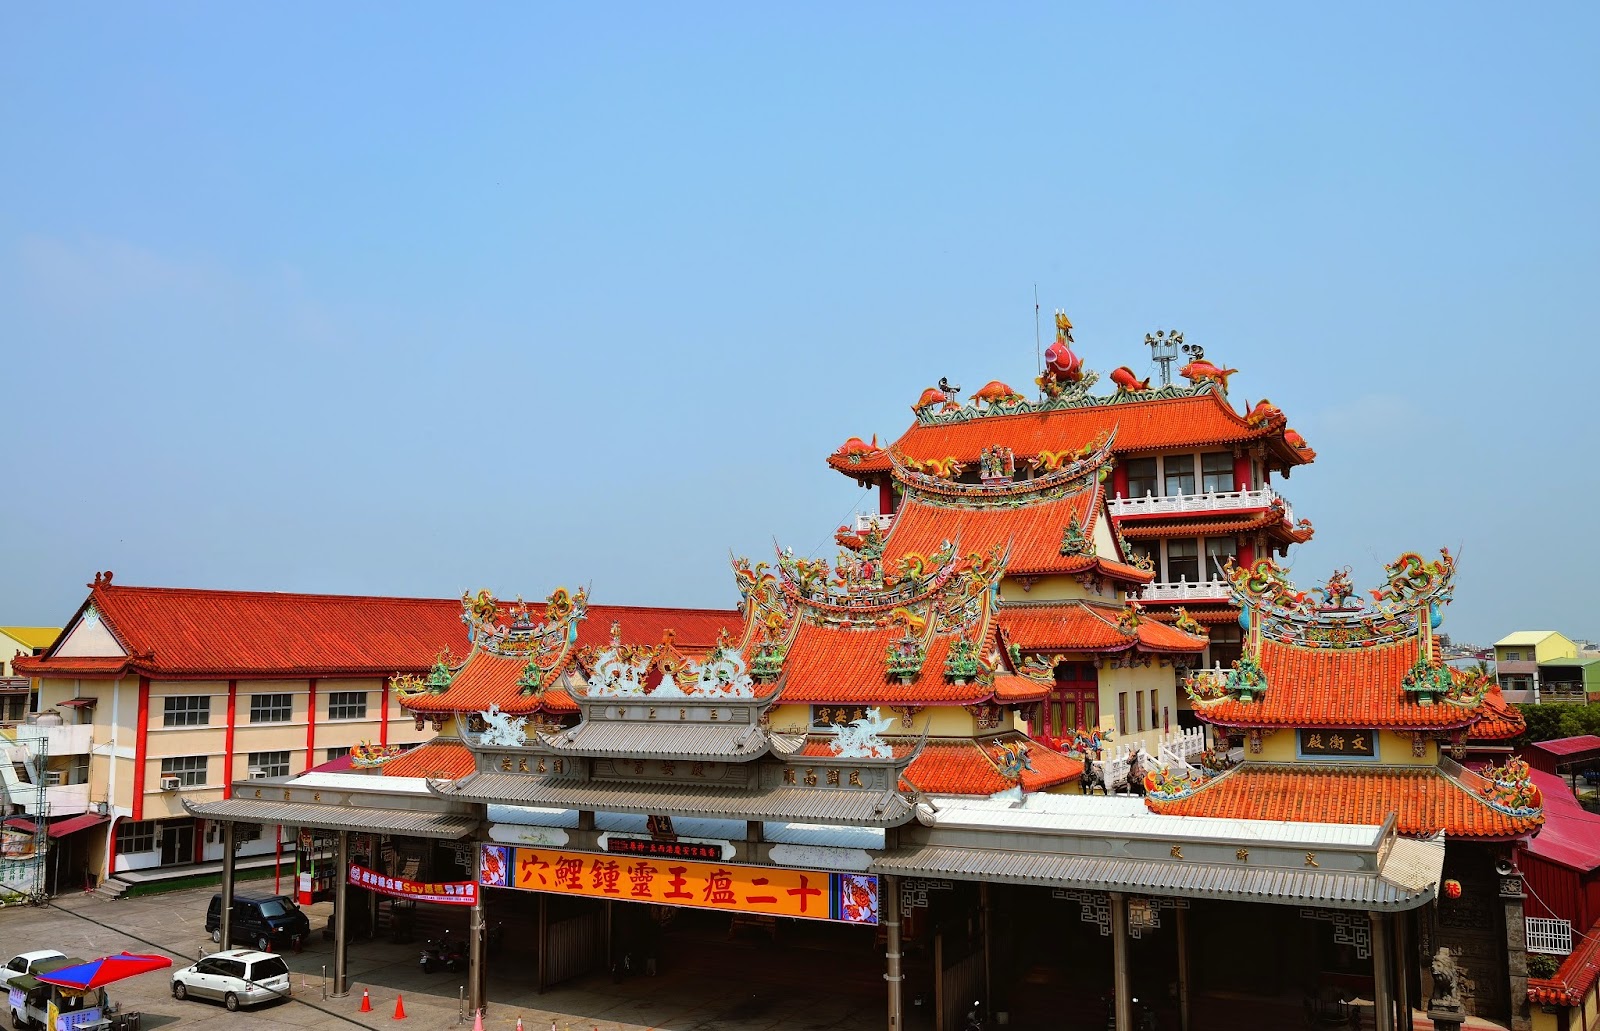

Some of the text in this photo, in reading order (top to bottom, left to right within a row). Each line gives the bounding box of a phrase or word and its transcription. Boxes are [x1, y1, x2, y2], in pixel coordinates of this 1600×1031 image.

[1307, 733, 1368, 751] 文衡殿
[783, 768, 863, 788] 風調雨順
[1170, 845, 1319, 868] 文衡殿
